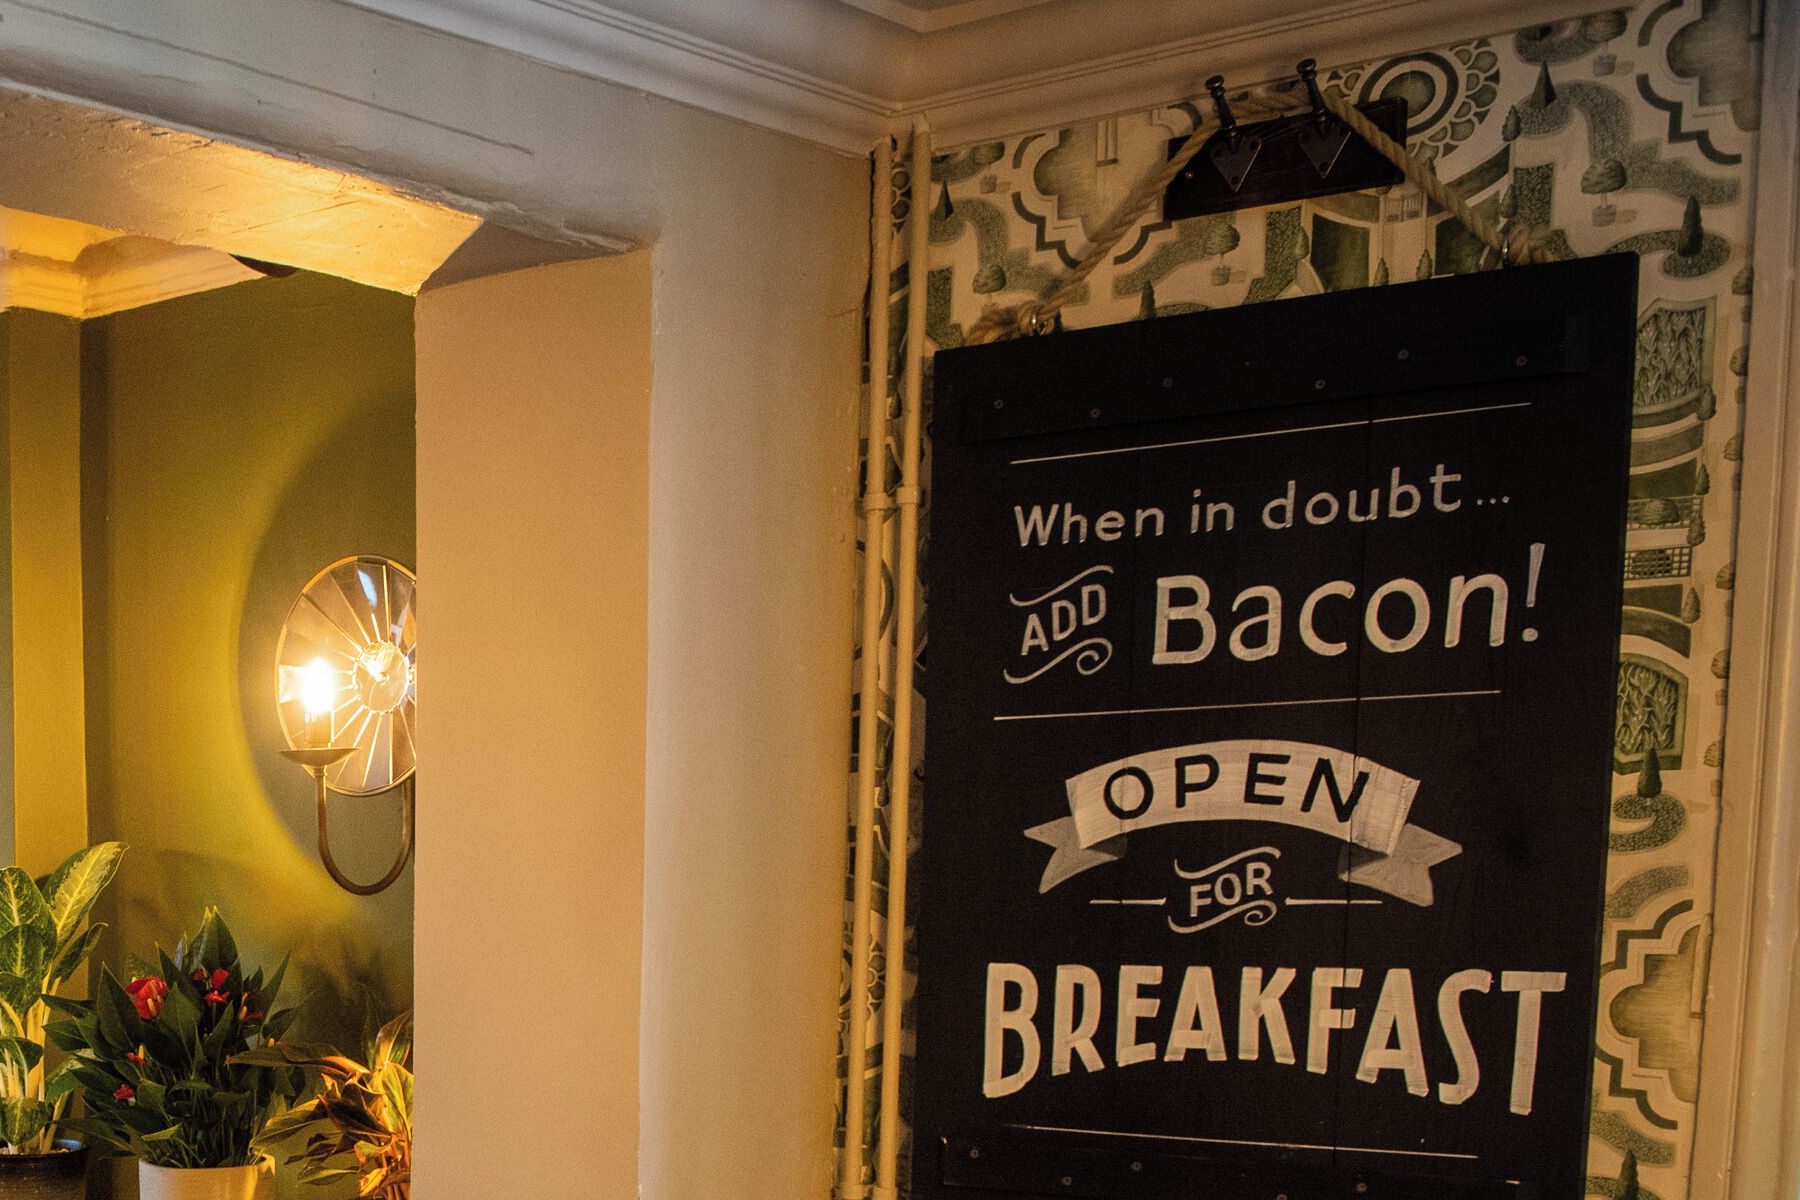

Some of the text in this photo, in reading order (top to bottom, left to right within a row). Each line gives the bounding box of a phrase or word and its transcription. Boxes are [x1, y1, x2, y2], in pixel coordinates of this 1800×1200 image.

[1015, 464, 1512, 547] When in doubt...
[1020, 543, 1545, 665] ADD Bacon!
[1103, 750, 1370, 823] OPEN
[1189, 861, 1274, 918] FOR
[983, 962, 1568, 1116] BREAKFAST
